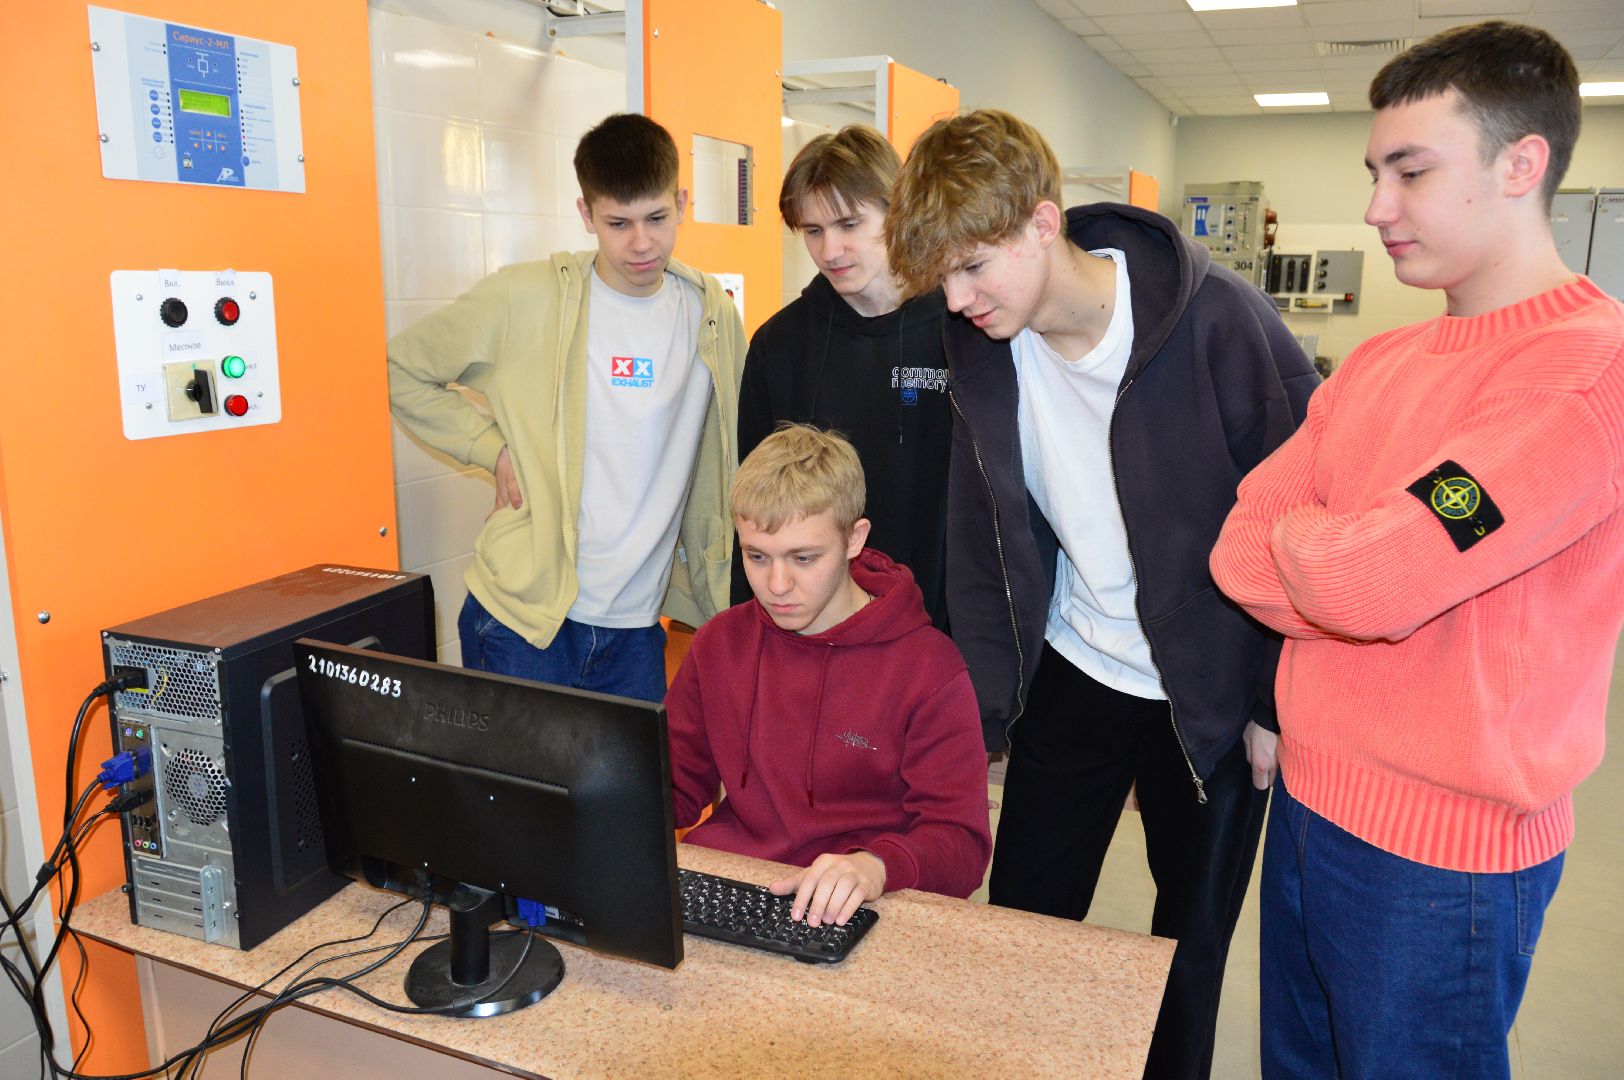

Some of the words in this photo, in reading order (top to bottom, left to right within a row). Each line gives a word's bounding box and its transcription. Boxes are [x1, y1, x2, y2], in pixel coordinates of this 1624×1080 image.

[172, 30, 229, 49] Сириус-2-МЛ
[1234, 260, 1253, 271] 304
[169, 342, 202, 352] Местное
[135, 383, 146, 393] ТУ
[611, 377, 655, 388] EXHAUST
[308, 654, 402, 698] 2101360283
[423, 702, 490, 732] PHILIPS
